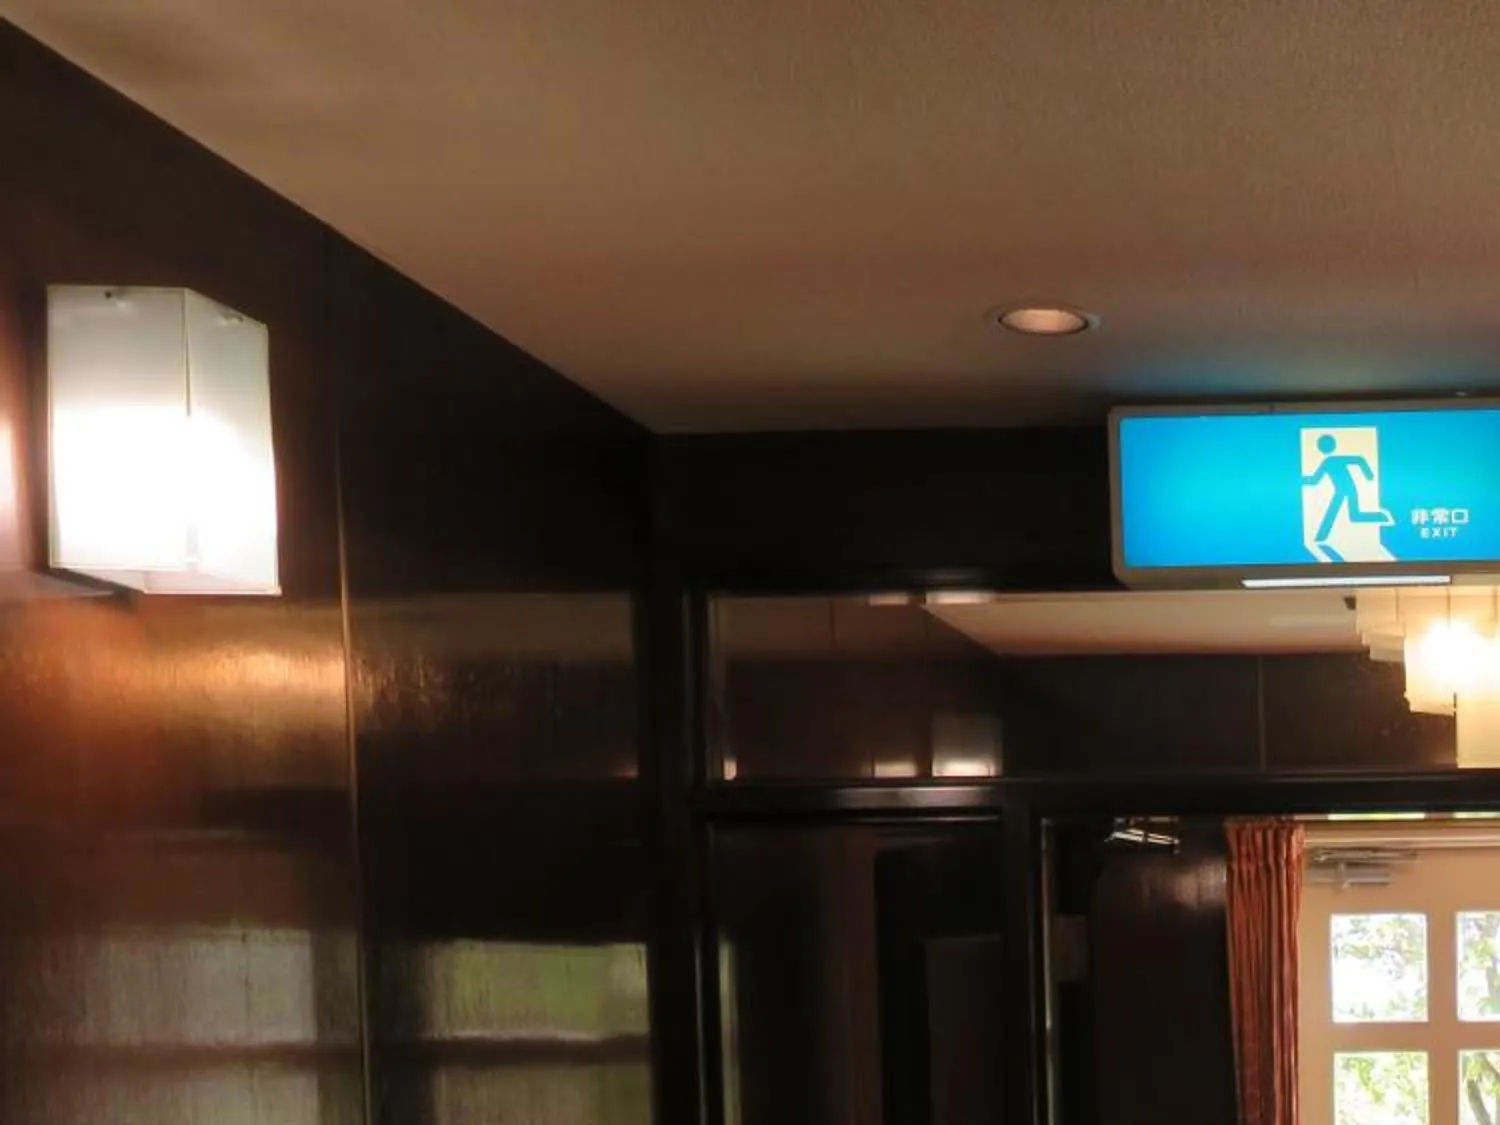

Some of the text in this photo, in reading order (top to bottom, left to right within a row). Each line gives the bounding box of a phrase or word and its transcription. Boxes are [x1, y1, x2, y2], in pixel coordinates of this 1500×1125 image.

[1410, 507, 1469, 525] 非常口
[1420, 527, 1457, 538] EXIT
